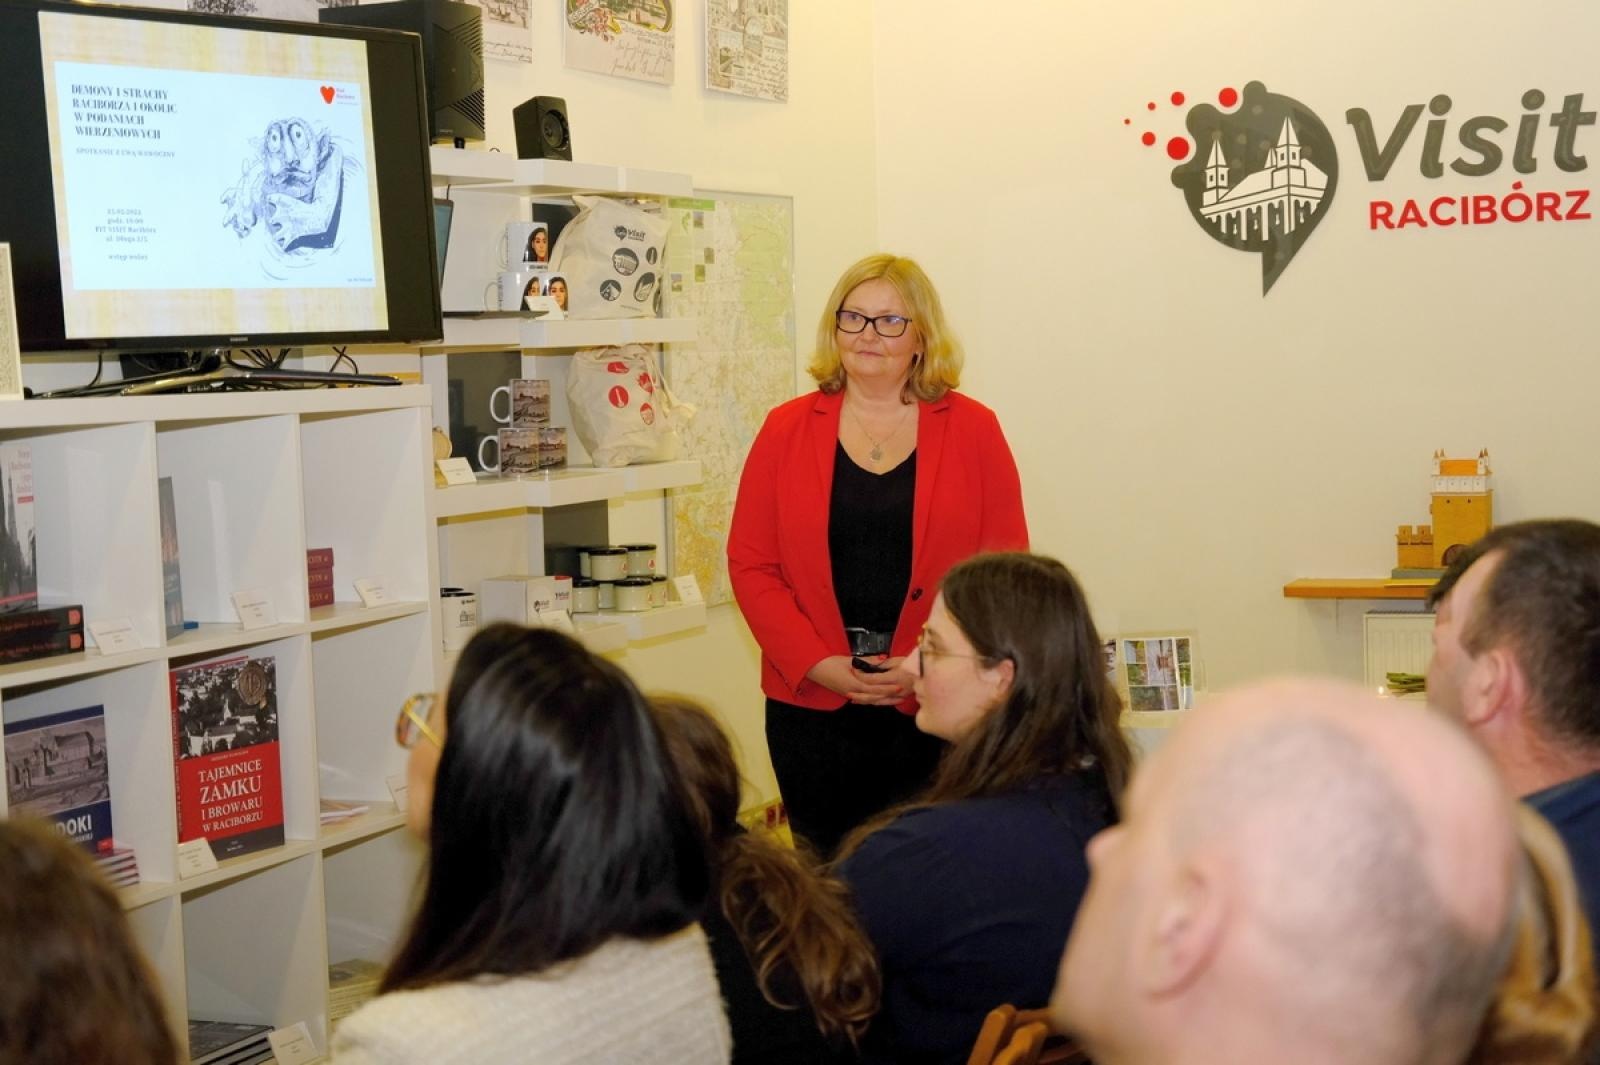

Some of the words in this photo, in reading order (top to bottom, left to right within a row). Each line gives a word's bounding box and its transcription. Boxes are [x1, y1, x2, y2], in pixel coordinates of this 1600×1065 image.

[71, 83, 113, 97] DEMONY
[122, 87, 168, 100] STRACHY
[72, 98, 131, 112] RACIBORZA
[139, 102, 178, 114] OKOLIC
[74, 111, 82, 122] W
[87, 111, 145, 125] PODANIACH
[1345, 88, 1597, 182] Visit
[1369, 181, 1592, 231] RACIBÓRZ
[198, 759, 263, 783] TAJEMNICE
[200, 775, 262, 805] ZAMKU
[207, 796, 264, 819] BROWARU
[202, 822, 211, 833] W
[212, 810, 264, 832] RACIBORZU
